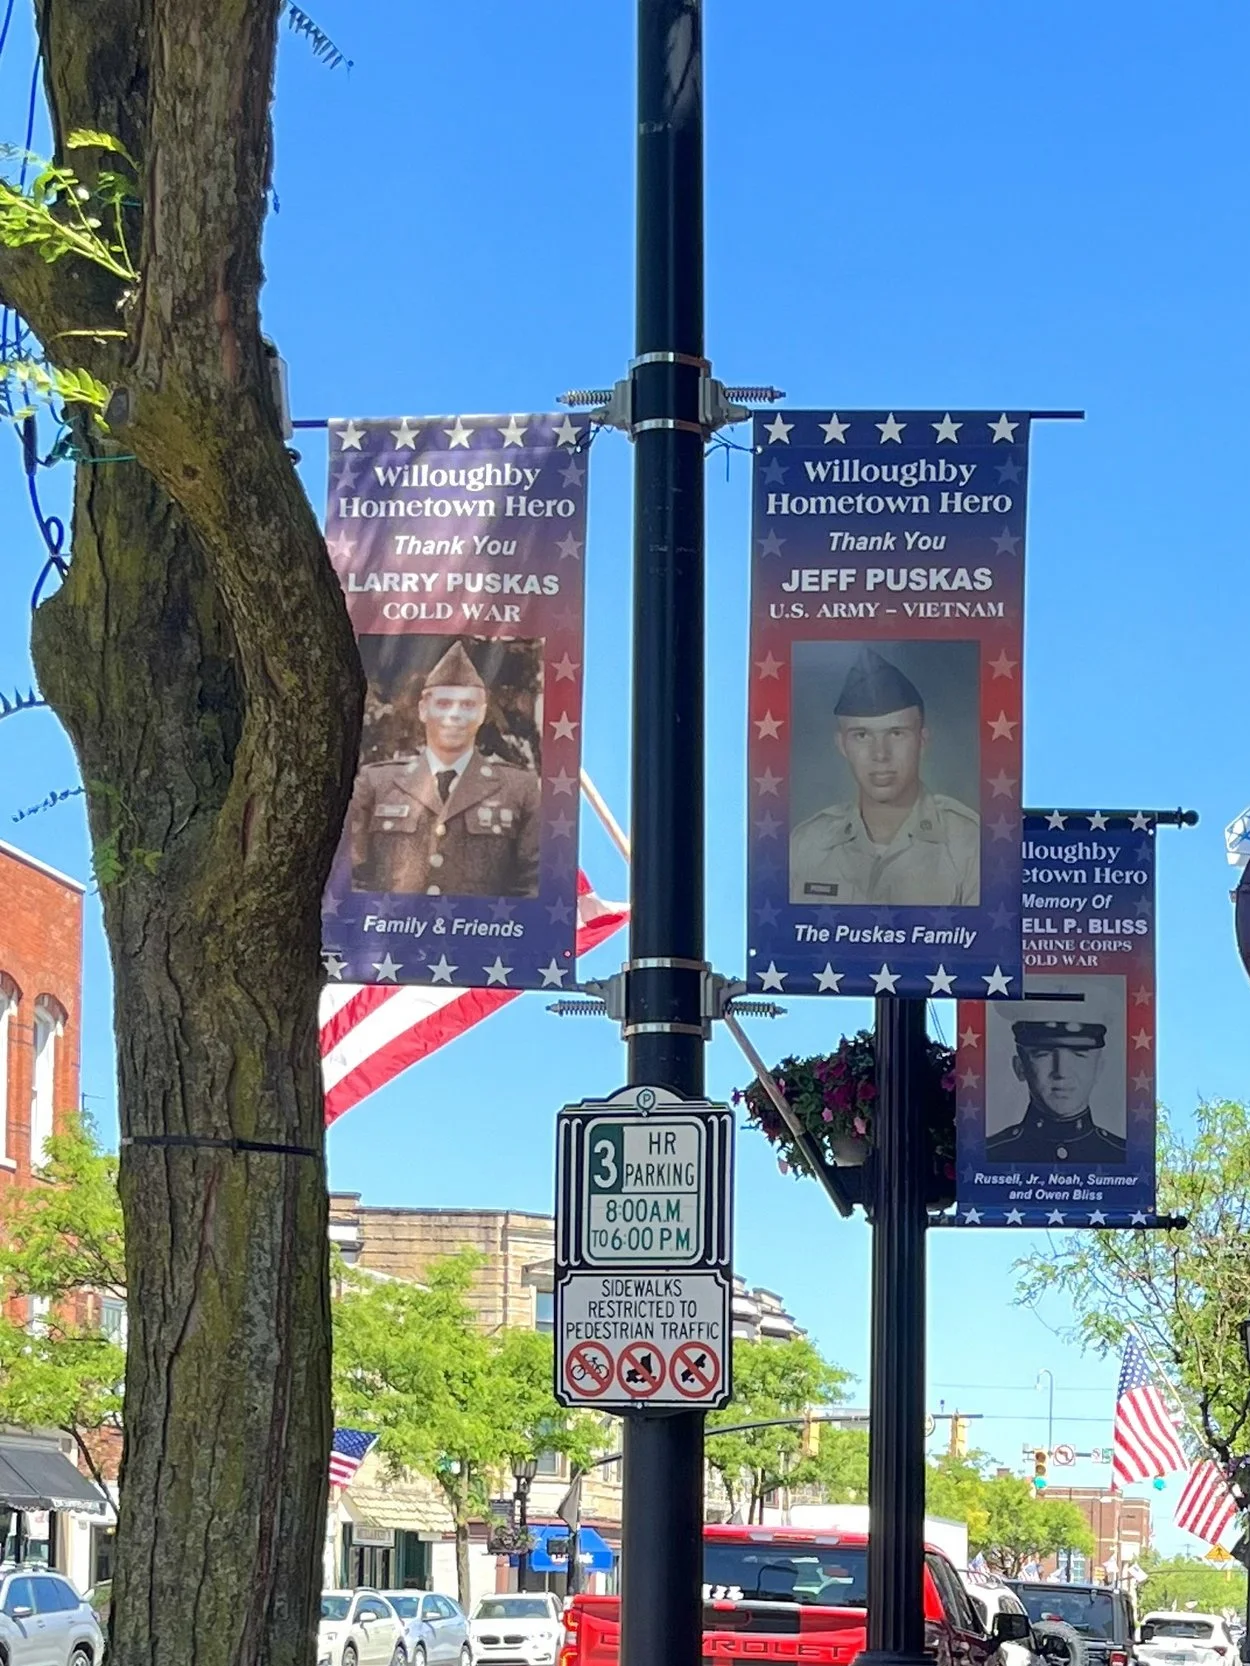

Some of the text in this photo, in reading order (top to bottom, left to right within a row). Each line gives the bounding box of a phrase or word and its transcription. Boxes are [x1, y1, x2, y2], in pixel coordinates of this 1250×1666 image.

[373, 463, 541, 492] Willoughby
[803, 458, 977, 487] Willoughby
[338, 496, 576, 518] Hometown Hero
[766, 491, 1013, 515] Hometown Hero
[394, 535, 517, 556] Thank You
[829, 531, 946, 551] Thank You
[347, 572, 560, 595] LARRY PUSKAS
[781, 567, 993, 593] JEFF PUSKAS
[382, 602, 521, 622] COLD WAR
[769, 602, 810, 619] U.S.
[816, 602, 880, 618] ARMY
[902, 601, 1004, 618] VIETNAM
[1021, 841, 1121, 864] lloughby
[1022, 867, 1148, 884] etown Hero
[1022, 893, 1113, 912] Memory Of
[363, 915, 524, 938] Family & Friends
[795, 925, 977, 948] The Puskas Family
[1063, 918, 1082, 934] P.
[1088, 918, 1148, 935] BLISS
[1022, 939, 1133, 952] ARINE CORPS
[1022, 954, 1098, 966] OLD WAR
[594, 1131, 677, 1189] 3 HR
[625, 1162, 695, 1187] PARKING
[1048, 1173, 1084, 1187] Noah,
[1087, 1173, 1138, 1186] Summer
[1009, 1189, 1103, 1201] and Owen Bliss
[592, 1229, 608, 1248] TO
[611, 1226, 654, 1251] 6:00
[601, 1278, 682, 1297] SIDEWALKS
[588, 1300, 697, 1318] RESTRICTED TO
[566, 1321, 720, 1340] PEDESTRIAN TRAFFIC
